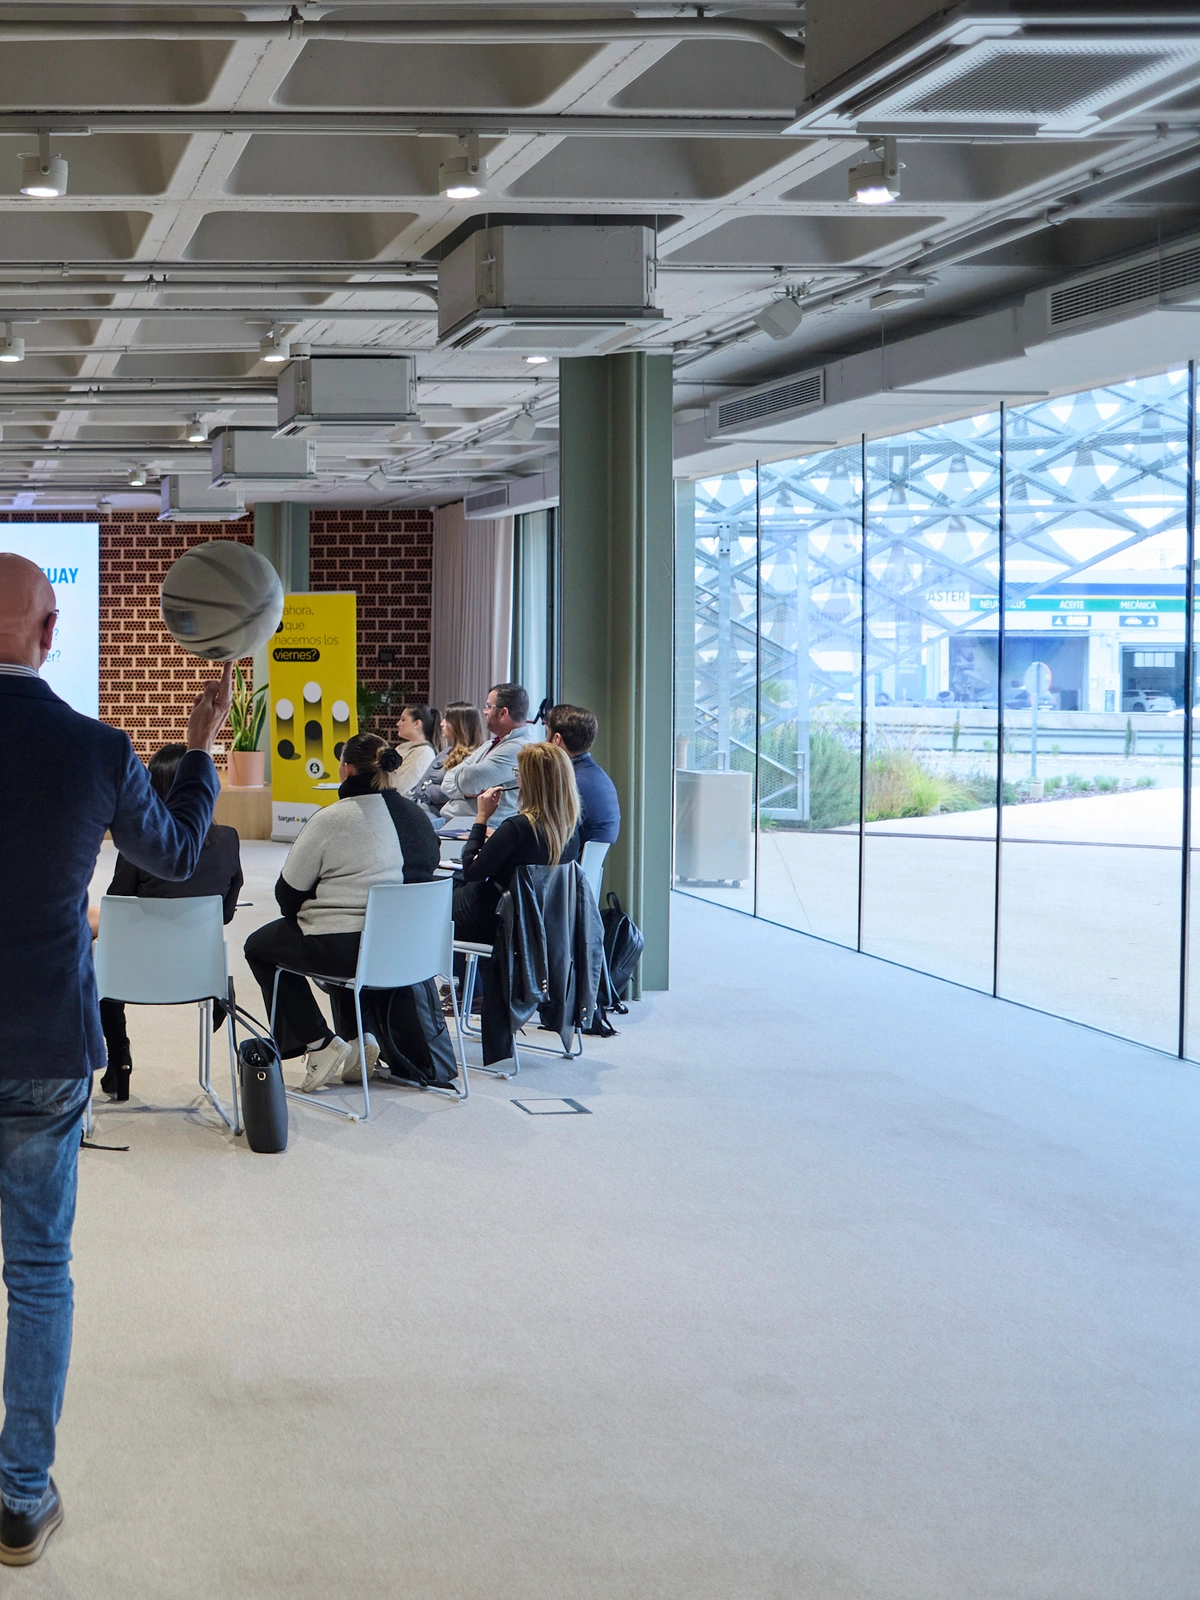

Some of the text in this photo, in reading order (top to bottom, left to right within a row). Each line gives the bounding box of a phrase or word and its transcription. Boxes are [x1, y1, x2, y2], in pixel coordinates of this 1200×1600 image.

[41, 567, 79, 584] UAY
[1059, 600, 1085, 609] ACEITE
[283, 605, 315, 616] ahora,
[285, 620, 305, 632] qué
[274, 634, 339, 646] hacemos los
[274, 649, 317, 660] viernes?
